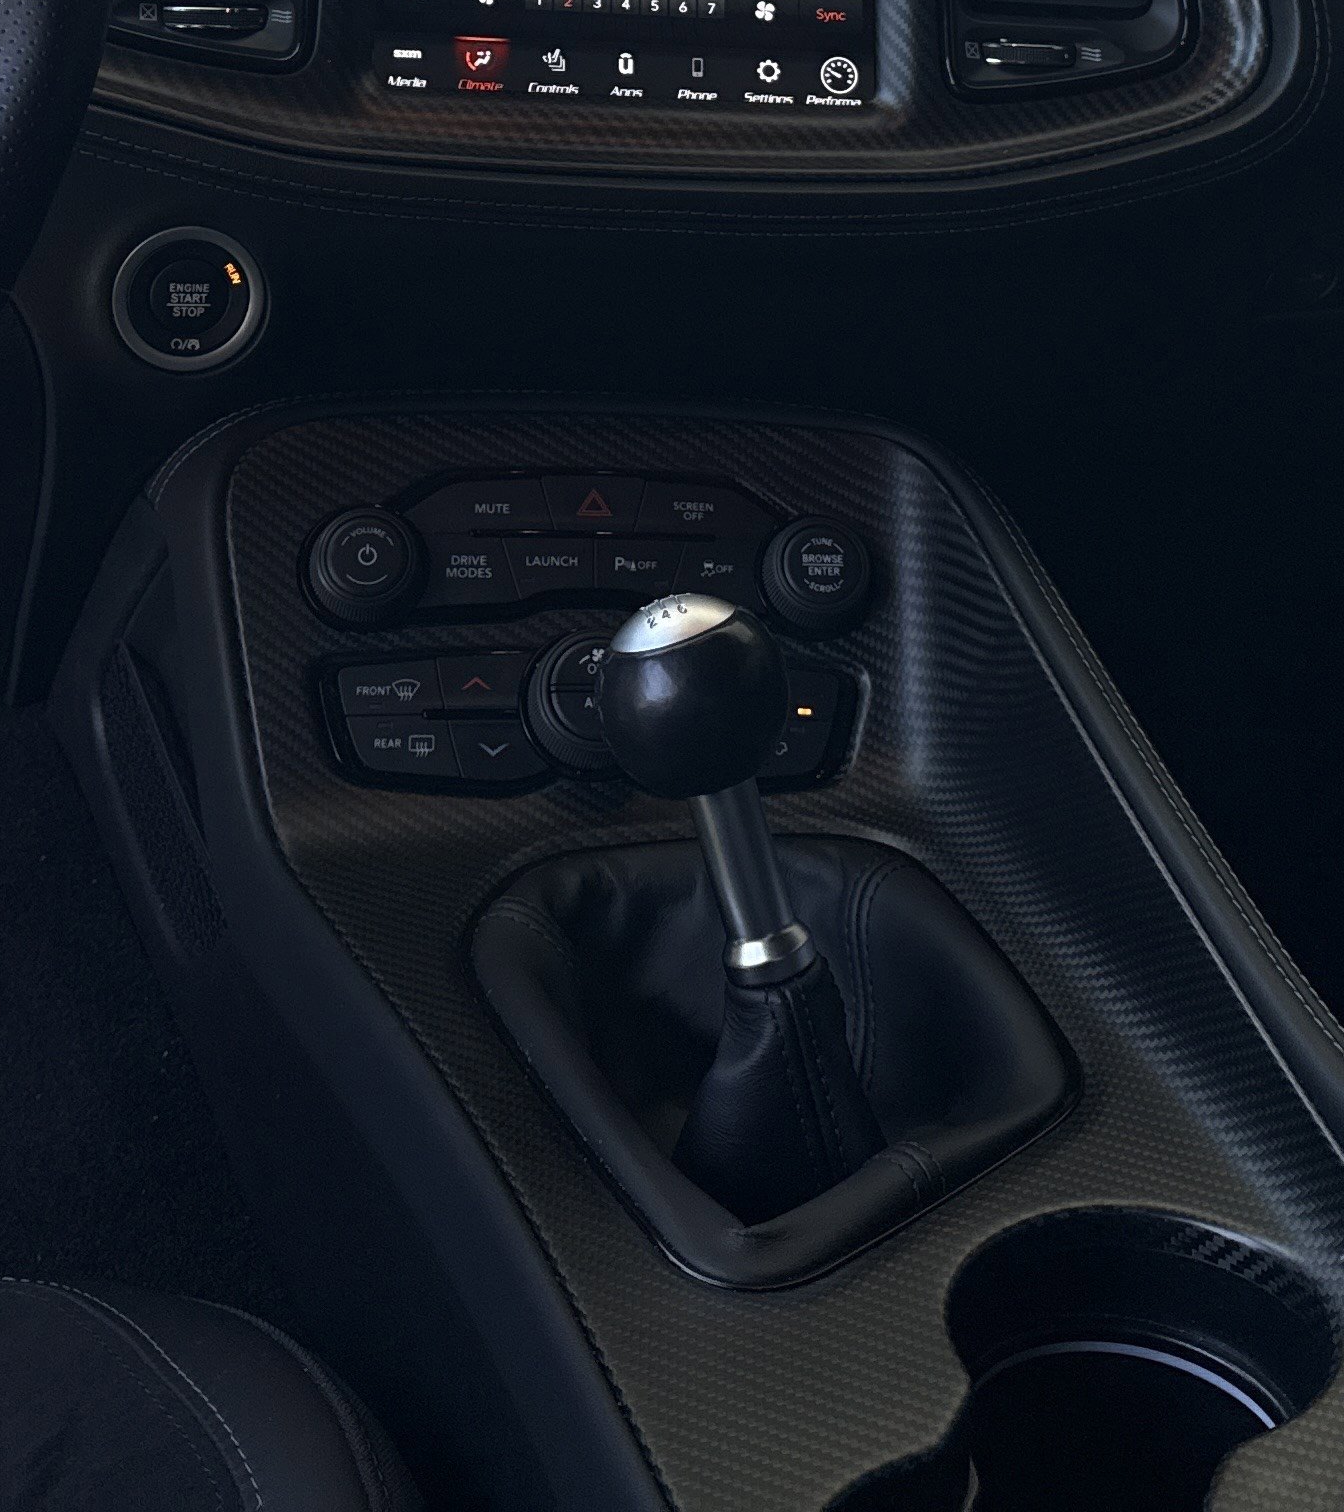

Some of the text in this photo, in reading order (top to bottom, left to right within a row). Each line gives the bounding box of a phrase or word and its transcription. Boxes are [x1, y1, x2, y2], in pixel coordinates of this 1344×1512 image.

[650, 0, 660, 12] 5
[678, 1, 688, 13] 6
[707, 2, 717, 15] 7
[815, 8, 847, 23] Sync
[458, 79, 504, 92] Climate
[223, 263, 242, 285] RUN
[169, 283, 210, 293] ENGINE
[170, 293, 208, 304] START
[172, 307, 206, 318] STOP
[474, 503, 511, 515] MUTE
[673, 500, 714, 513] SCREEN
[683, 511, 705, 522] OFF
[450, 555, 488, 567] DRIVE
[525, 555, 579, 568] LAUNCH
[801, 553, 844, 565] BROWSE
[637, 560, 658, 571] OFF
[715, 564, 735, 574] OFF
[807, 566, 841, 577] ENTER
[445, 567, 493, 579] MODES
[356, 685, 391, 697] FRONT
[373, 738, 402, 749] REAR
